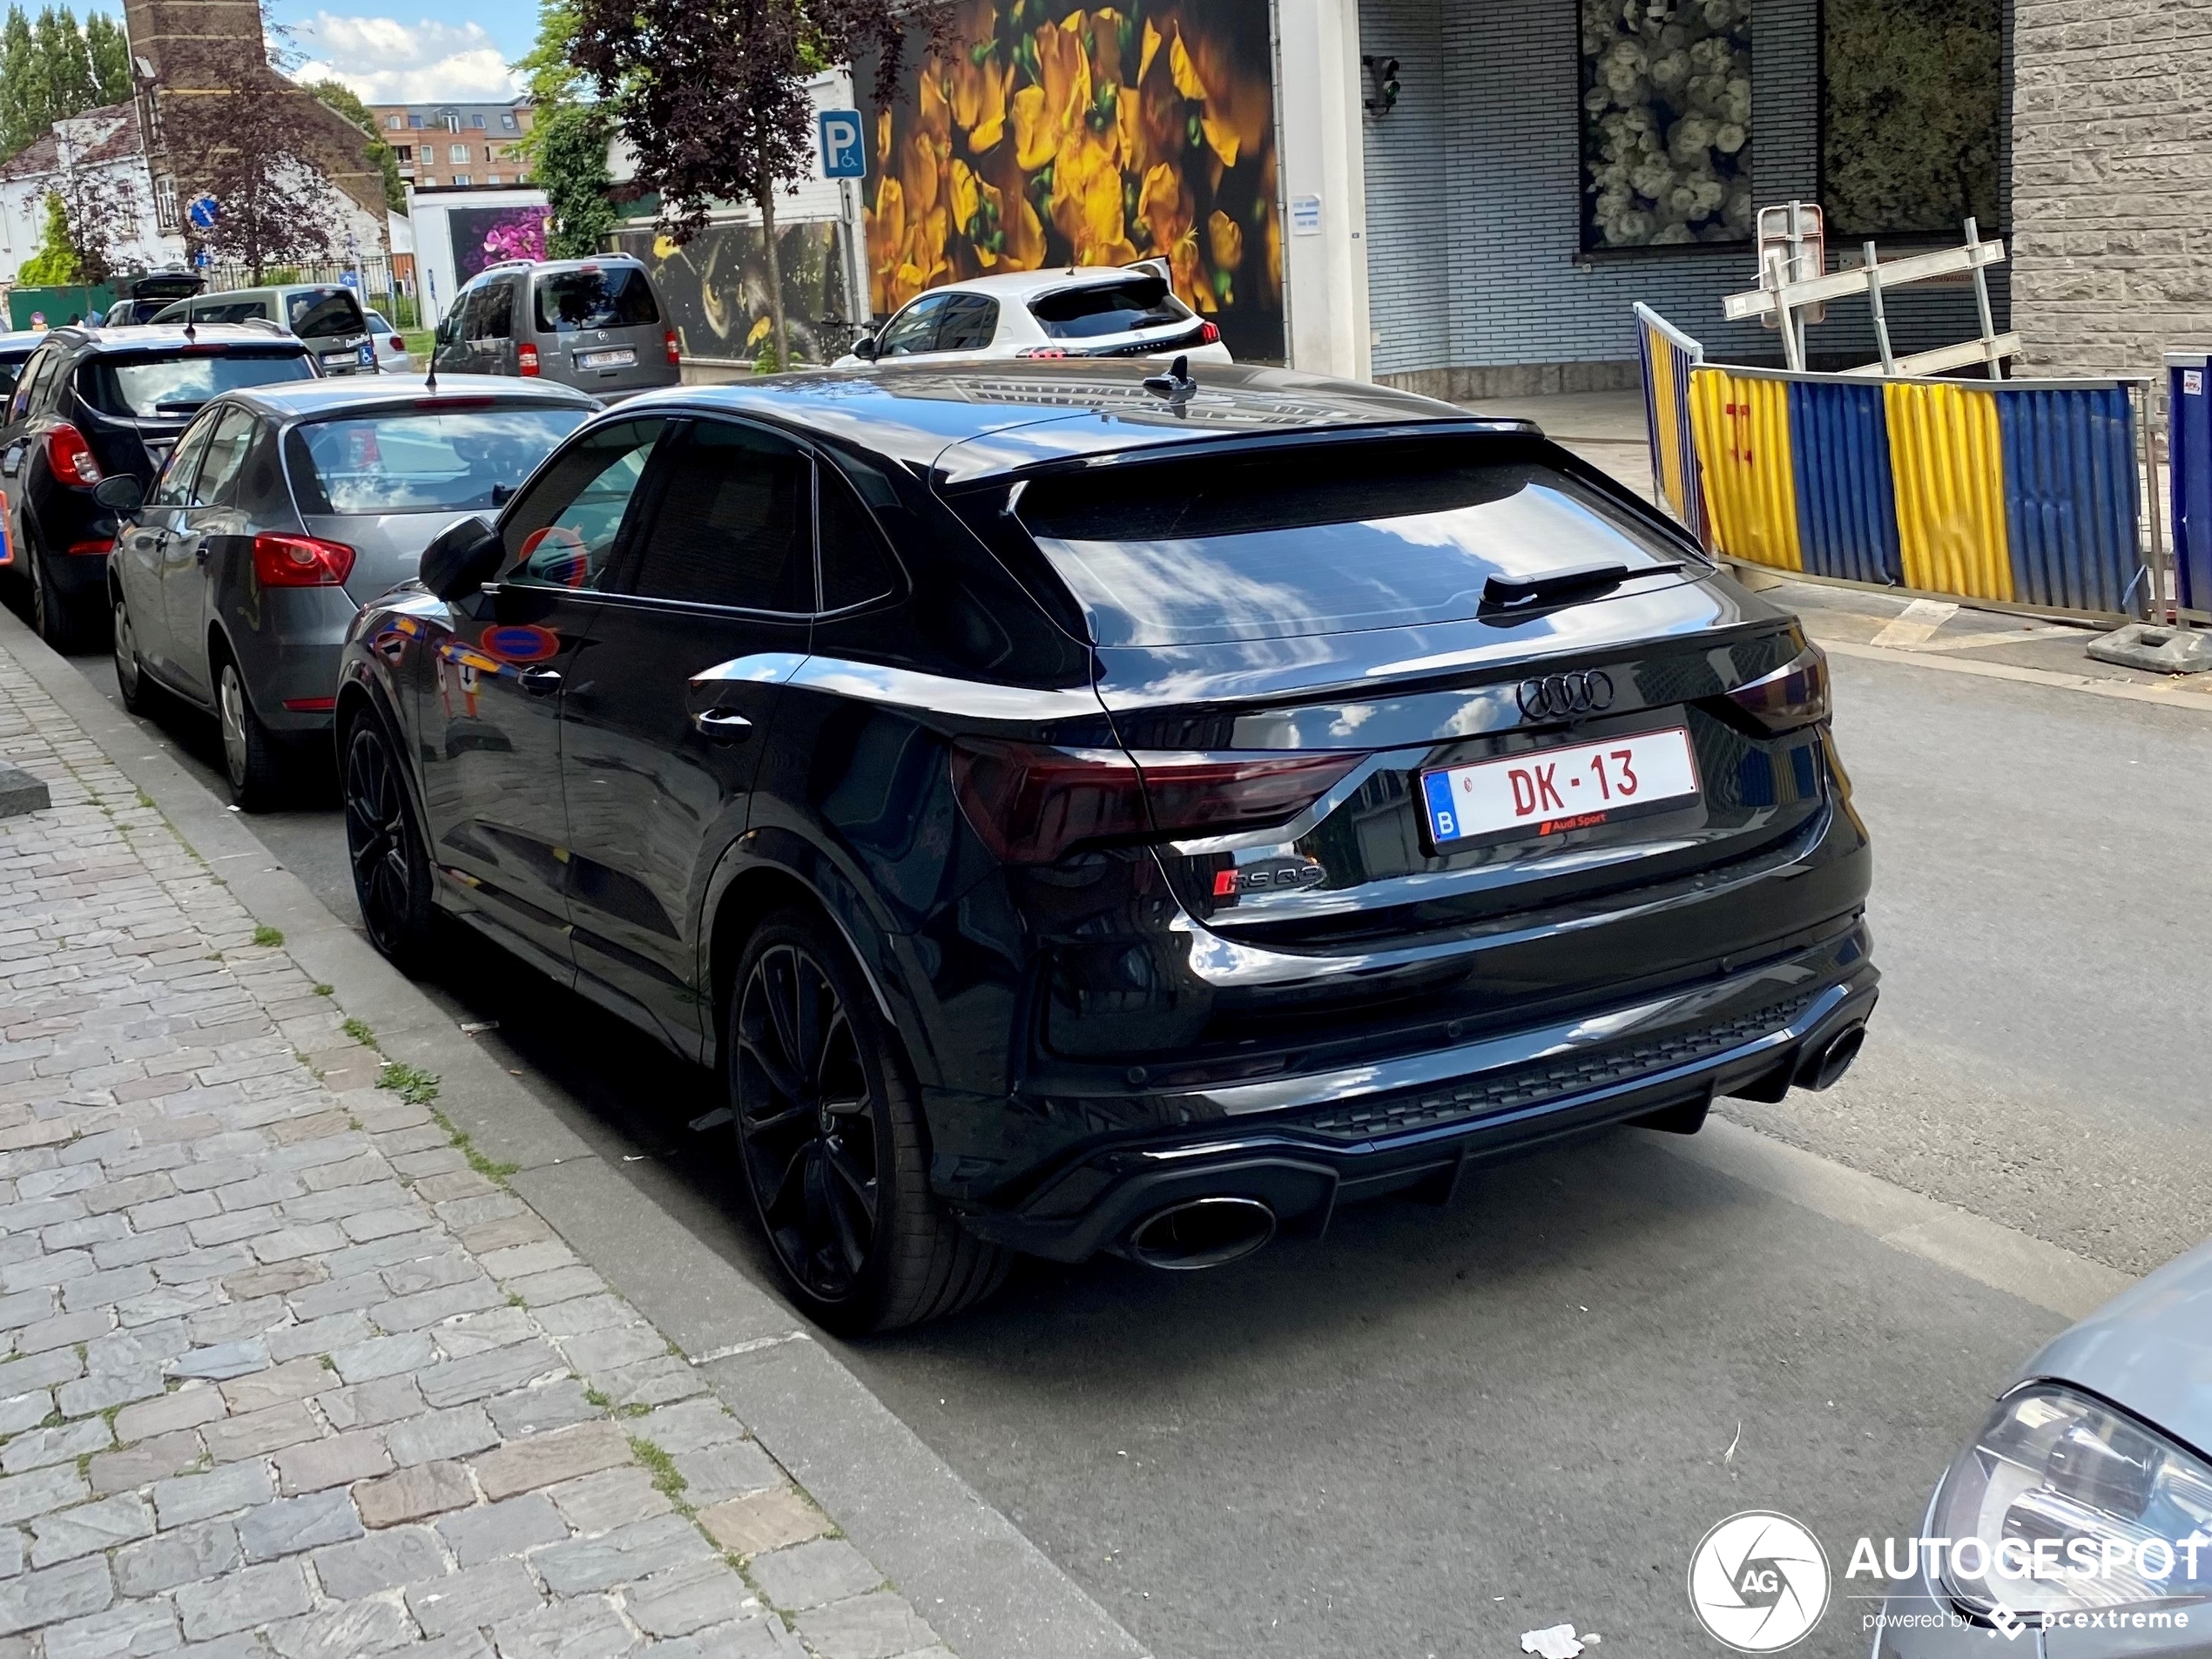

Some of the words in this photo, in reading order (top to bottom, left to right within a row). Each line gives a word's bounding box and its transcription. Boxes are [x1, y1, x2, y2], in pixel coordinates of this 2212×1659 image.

[826, 121, 856, 168] P
[1437, 812, 1454, 833] B
[1554, 819, 1576, 831] Audi
[1577, 813, 1607, 827] Sport
[1230, 872, 1271, 889] RS
[1274, 865, 1324, 885] Q3
